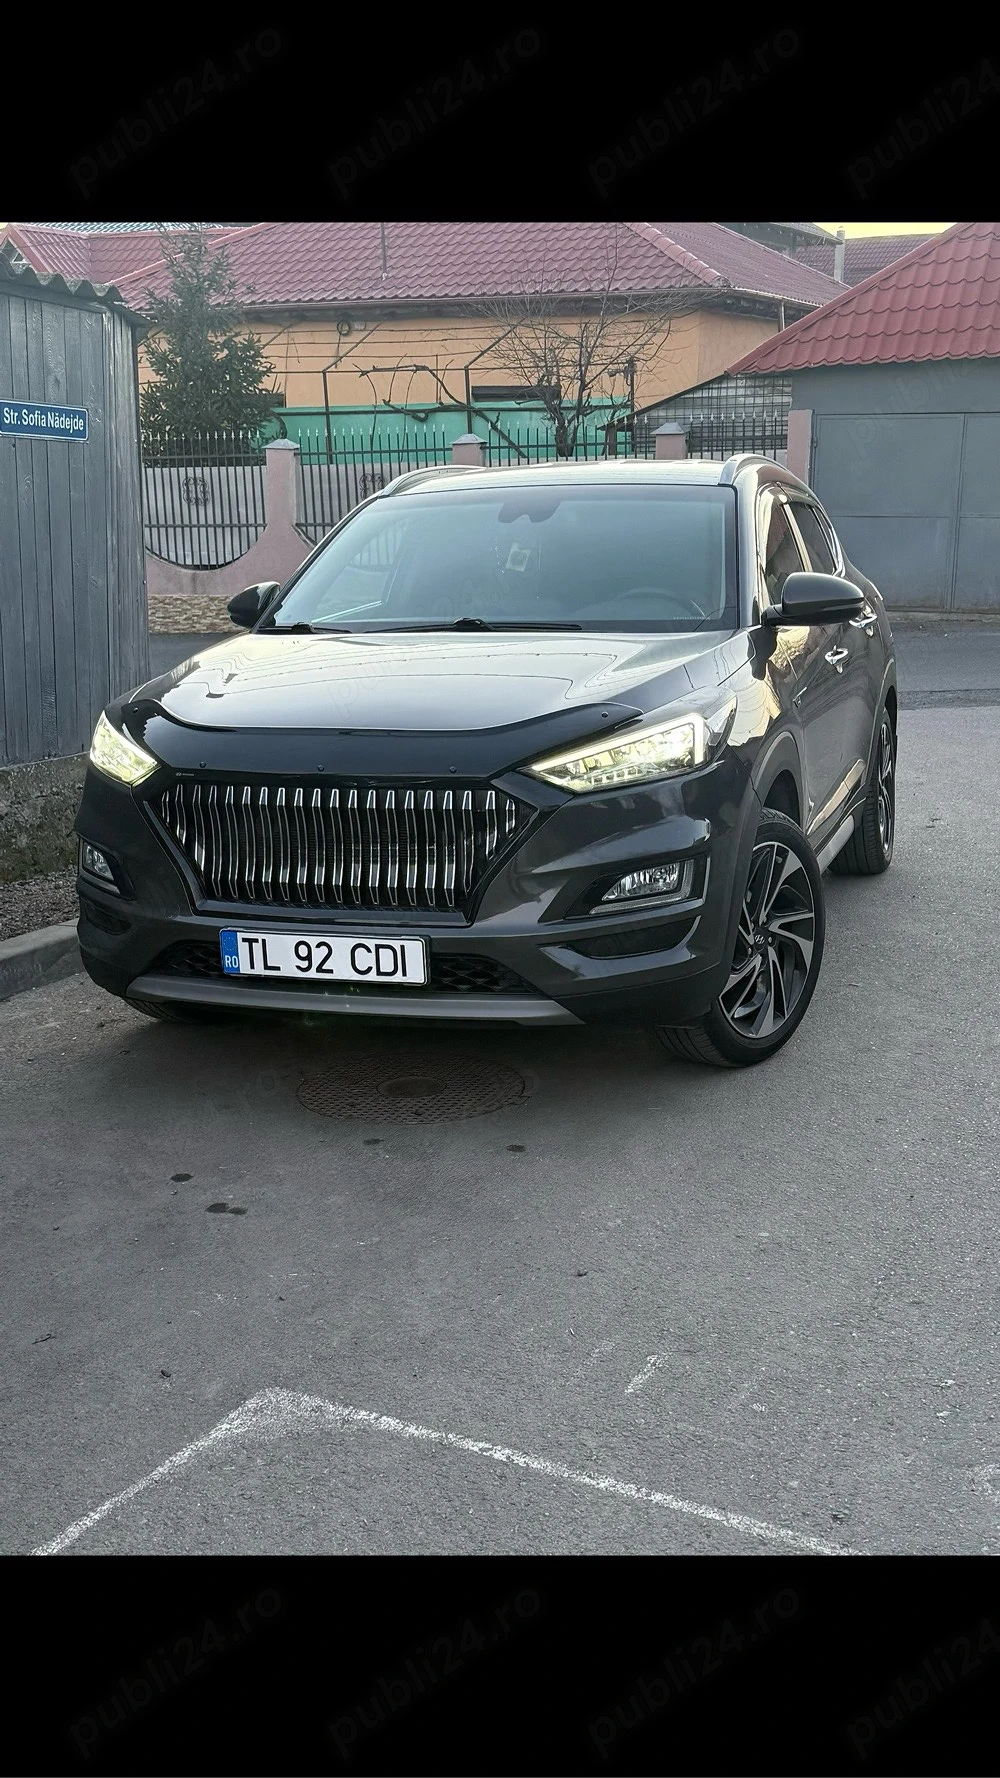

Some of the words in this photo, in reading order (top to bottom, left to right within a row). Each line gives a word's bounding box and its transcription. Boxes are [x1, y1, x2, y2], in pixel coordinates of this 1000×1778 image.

[3, 407, 21, 425] Str.
[22, 409, 46, 427] Sofia
[47, 411, 84, 434] Nădejde
[225, 955, 239, 968] RO
[241, 937, 281, 971] TL
[294, 940, 334, 974] 92
[350, 943, 407, 978] CDI
